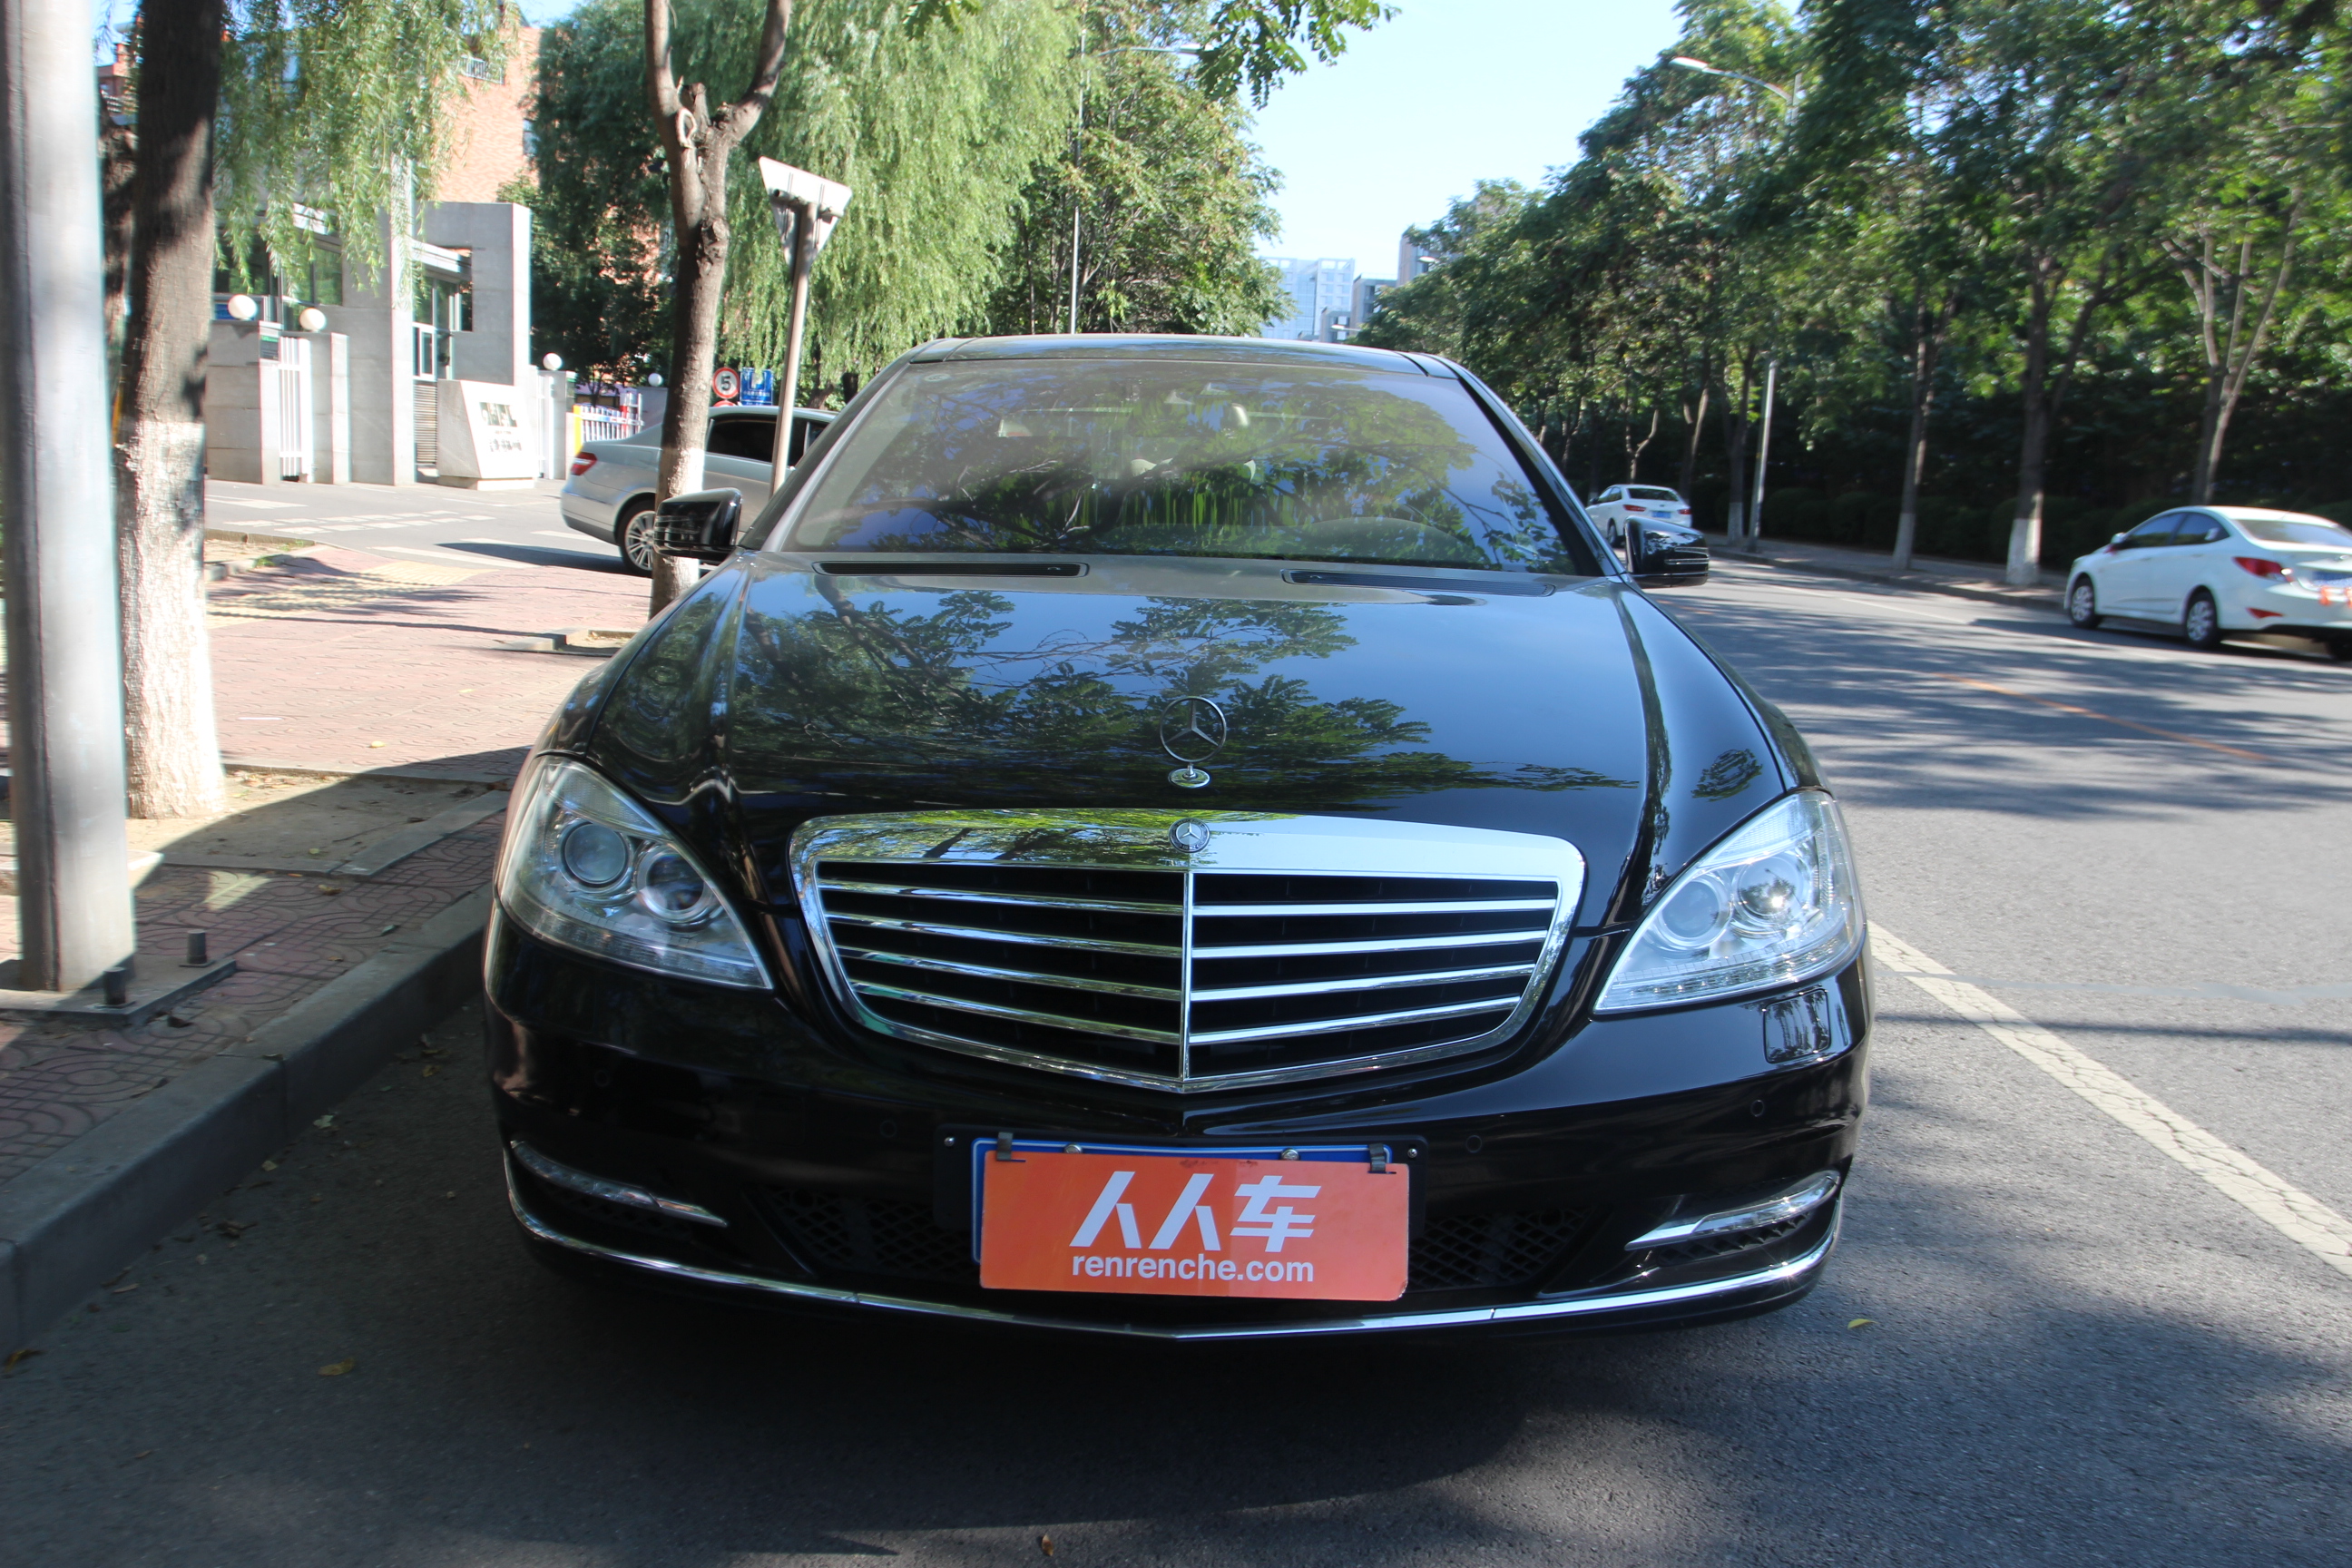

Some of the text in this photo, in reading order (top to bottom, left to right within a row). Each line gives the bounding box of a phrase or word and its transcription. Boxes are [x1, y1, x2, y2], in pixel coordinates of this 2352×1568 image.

[720, 375, 731, 391] 5
[1069, 1171, 1322, 1252] 人人车
[1072, 1253, 1314, 1282] renrenche.com
